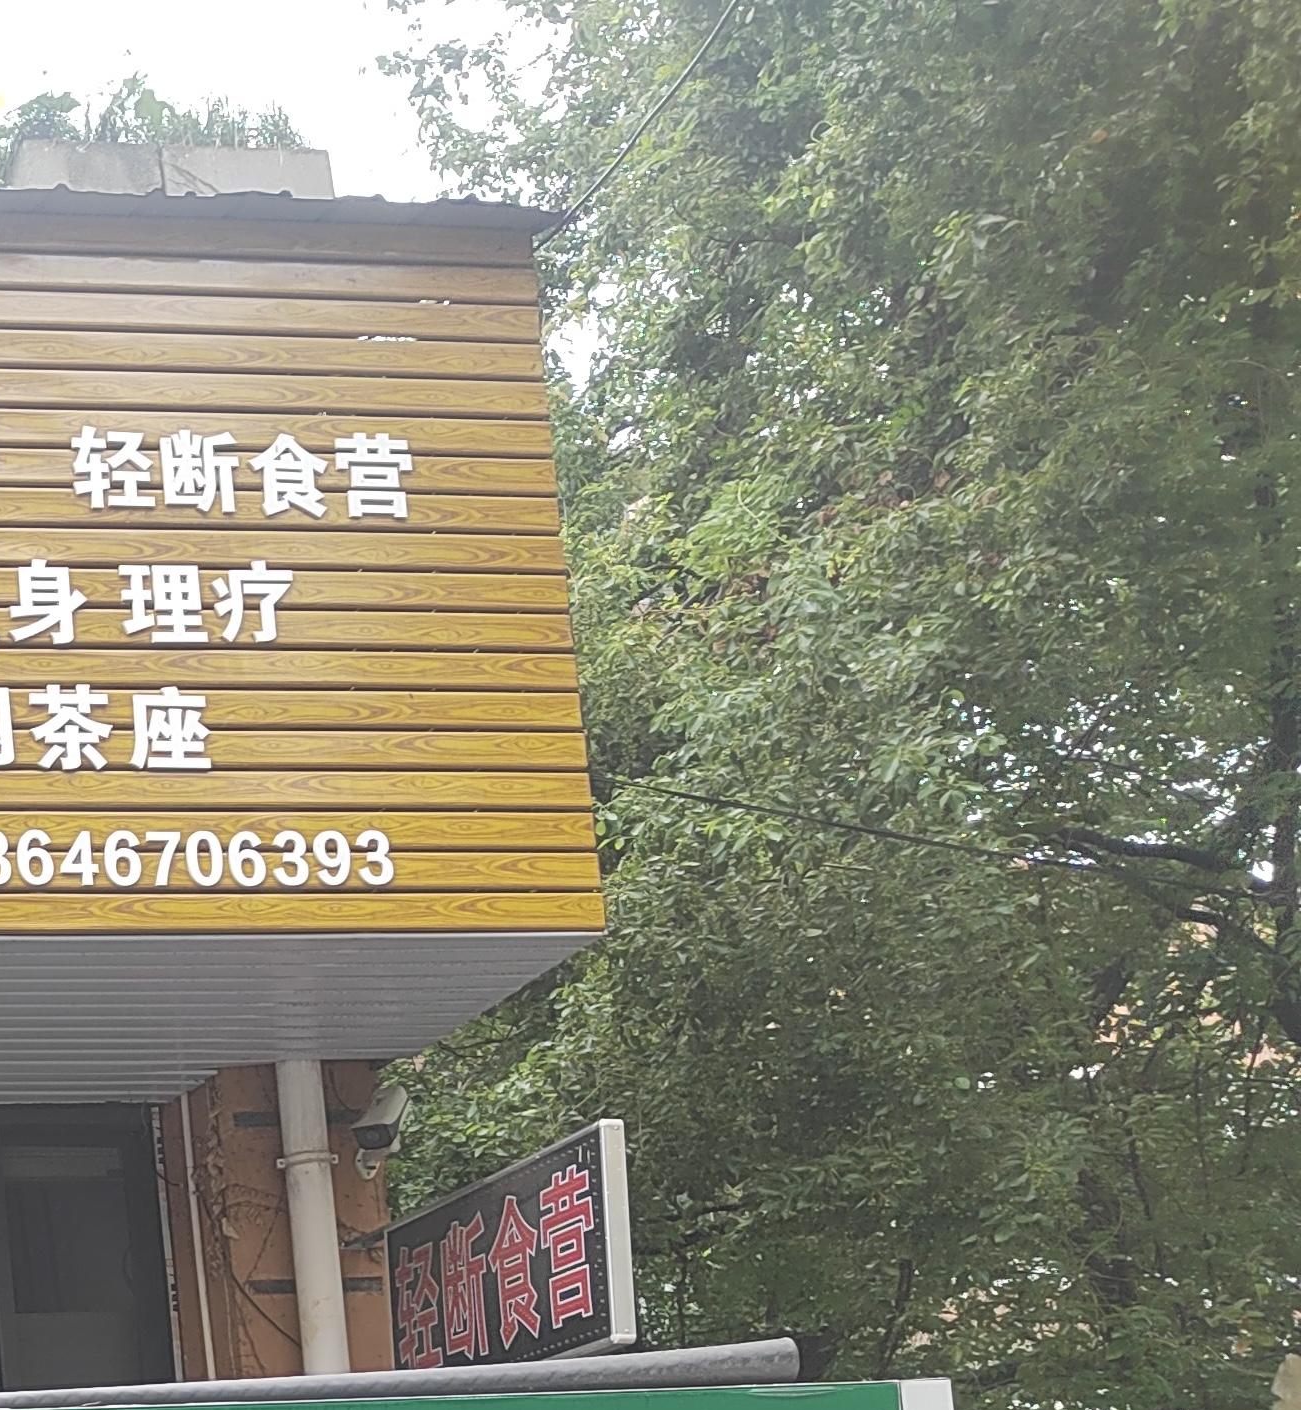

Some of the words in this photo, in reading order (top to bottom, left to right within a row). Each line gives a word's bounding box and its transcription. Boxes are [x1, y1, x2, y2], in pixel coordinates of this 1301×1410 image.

[70, 425, 413, 518] 轻断食营
[117, 561, 294, 643] 理疗
[396, 1164, 594, 1370] 轻断食营
